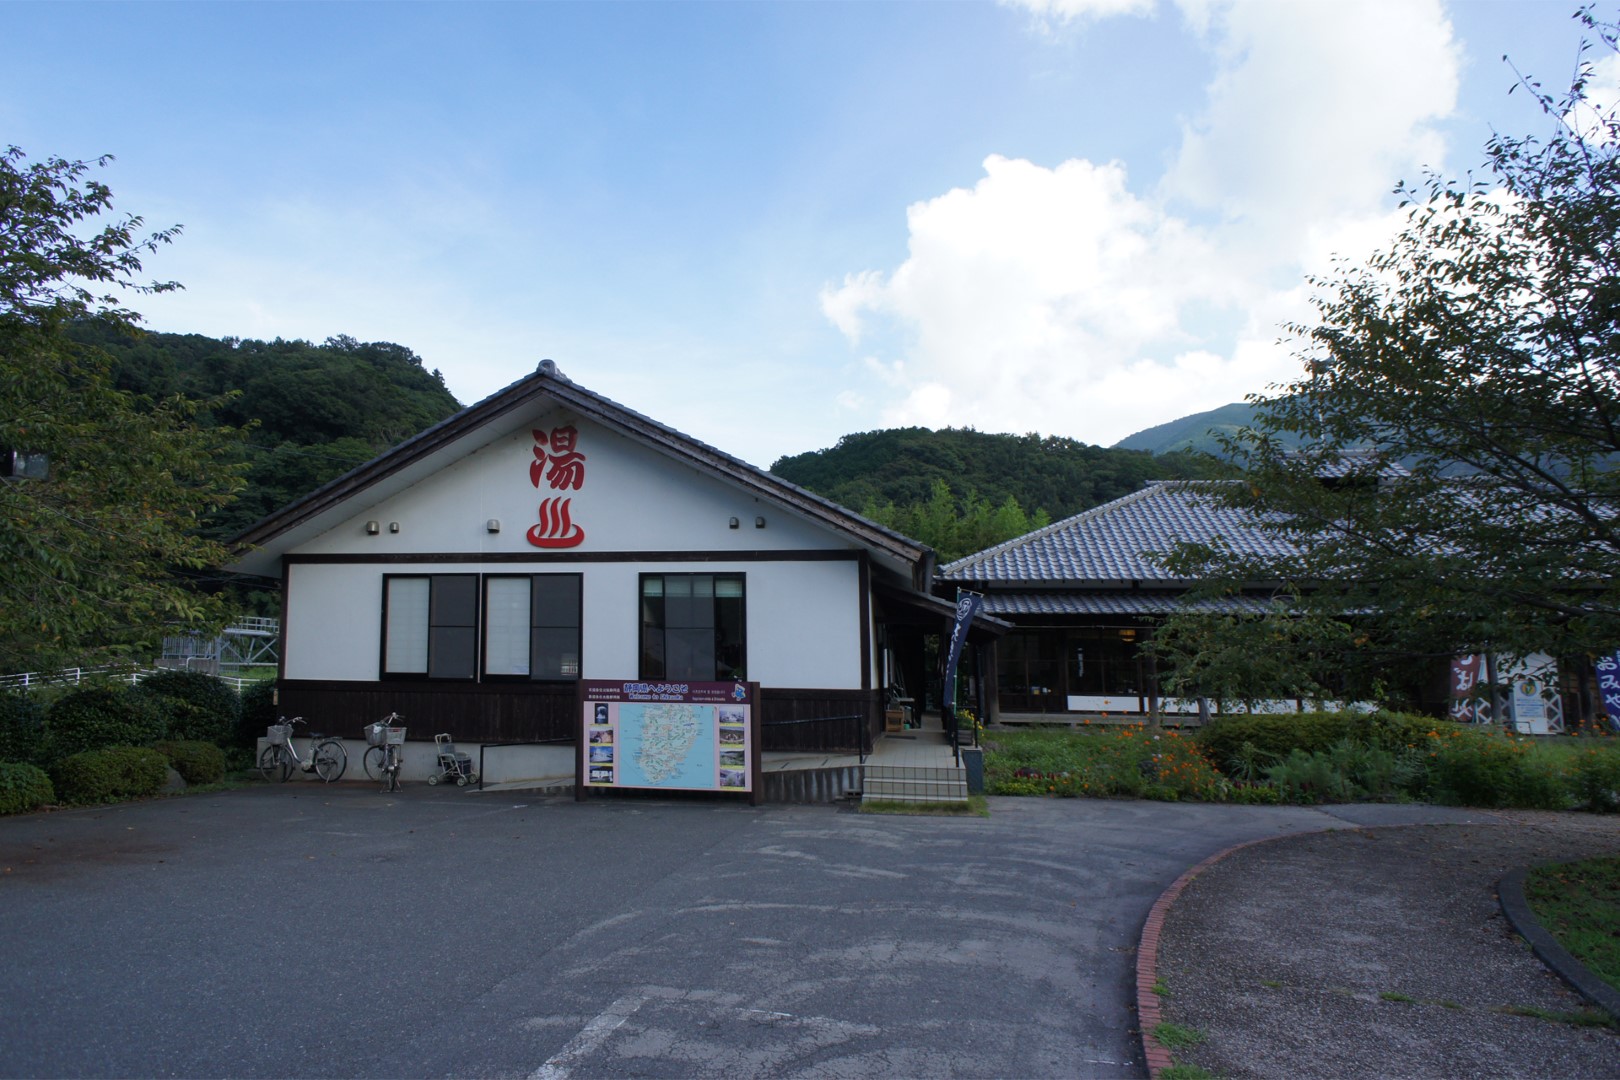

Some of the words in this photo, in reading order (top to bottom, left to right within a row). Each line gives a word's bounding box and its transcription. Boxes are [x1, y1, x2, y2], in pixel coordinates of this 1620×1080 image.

[530, 425, 586, 490] 湯
[623, 682, 689, 693] 静岡県へようこそ
